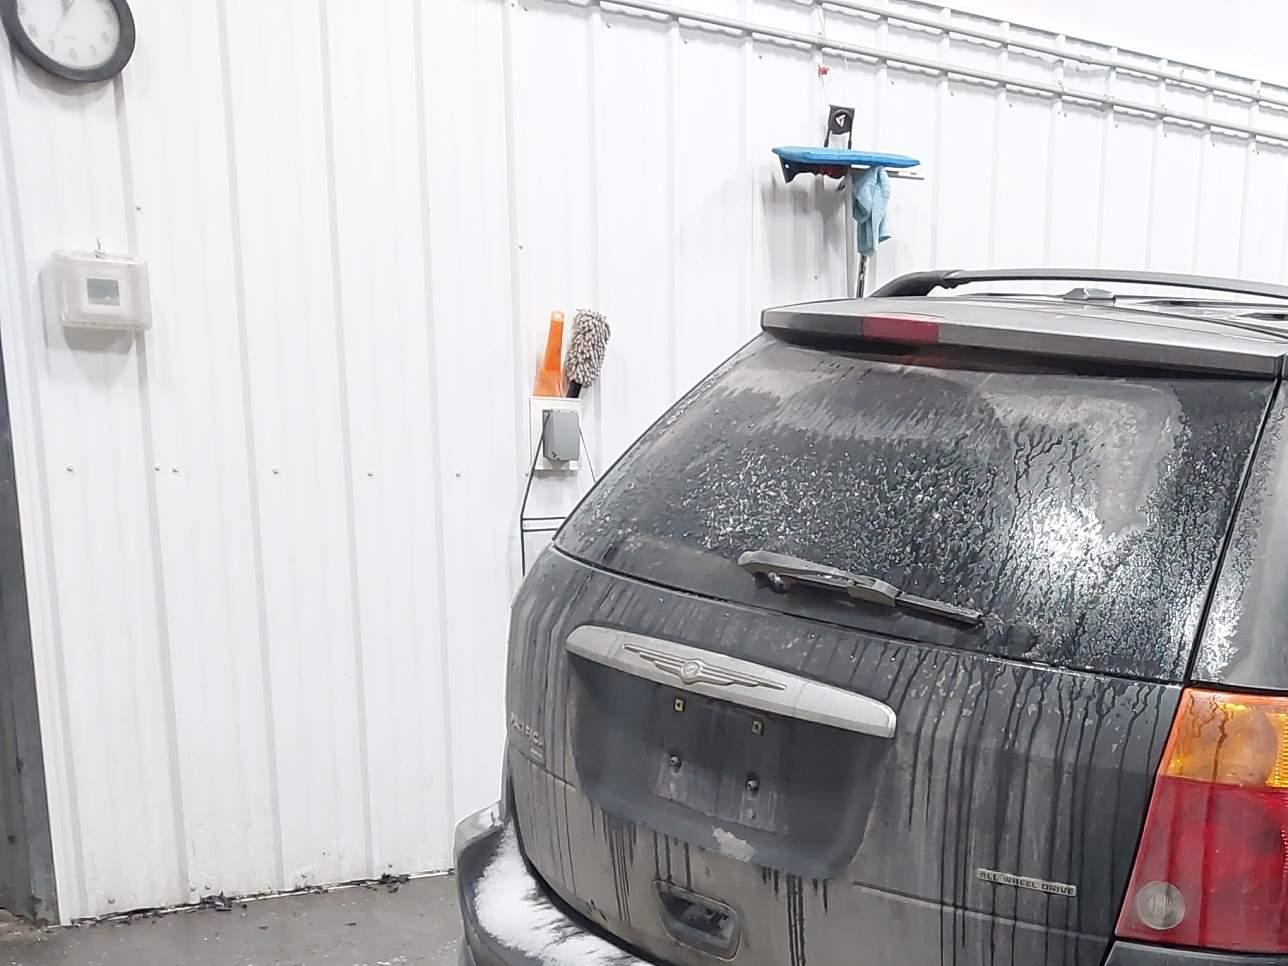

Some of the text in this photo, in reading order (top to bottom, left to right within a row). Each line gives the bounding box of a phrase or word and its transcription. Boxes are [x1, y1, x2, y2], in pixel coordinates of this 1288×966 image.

[978, 870, 1074, 895] ALL WHEEL DRIVE
